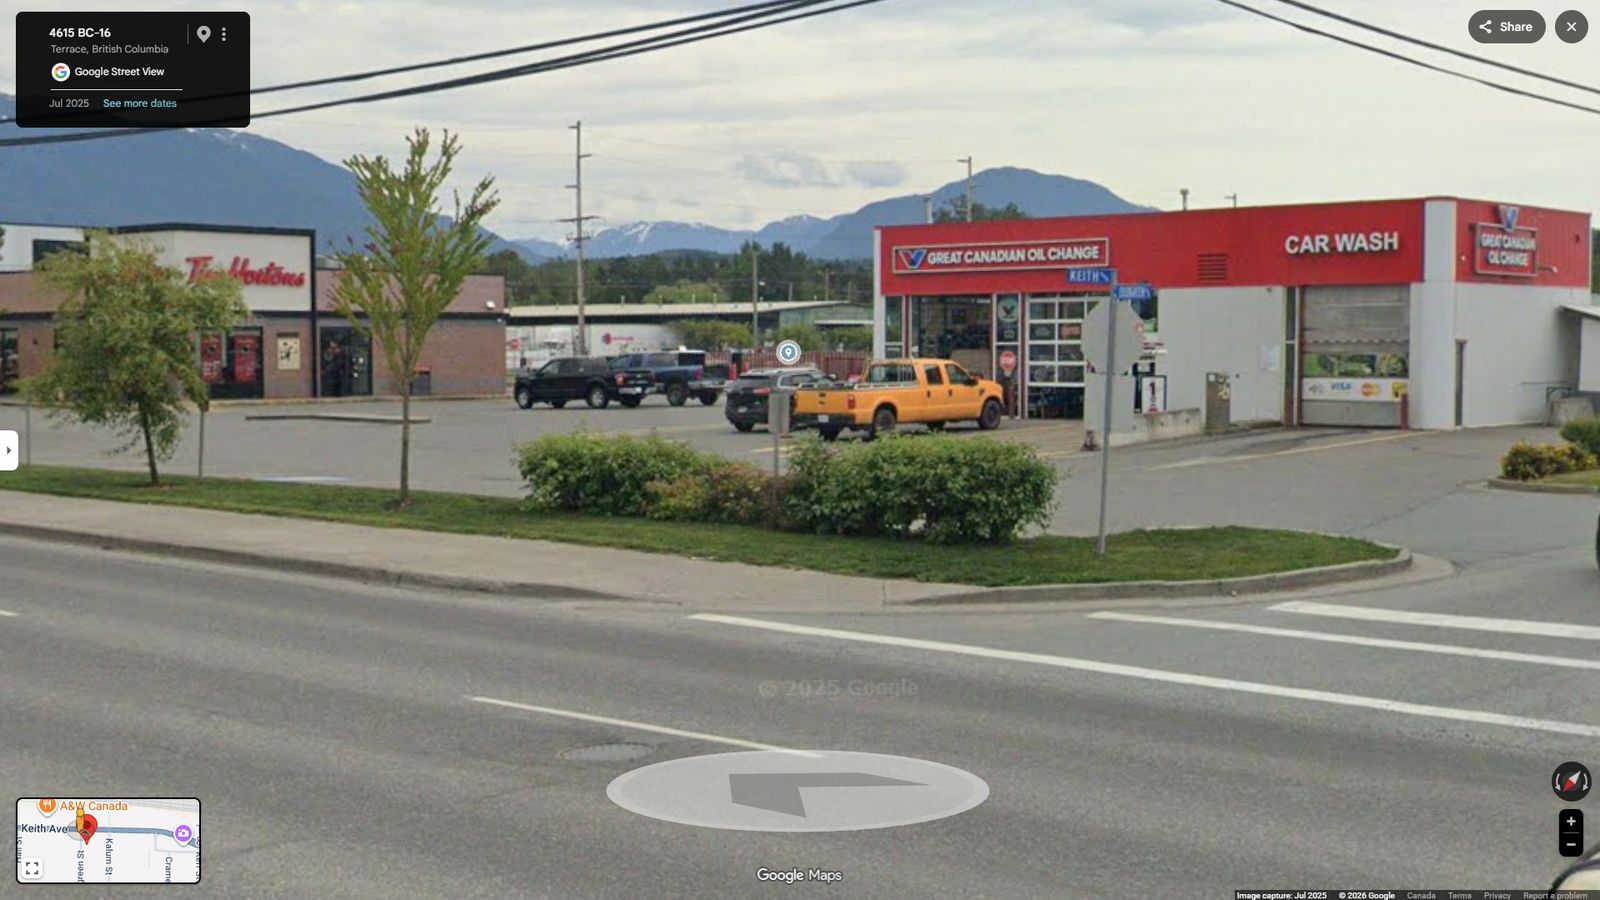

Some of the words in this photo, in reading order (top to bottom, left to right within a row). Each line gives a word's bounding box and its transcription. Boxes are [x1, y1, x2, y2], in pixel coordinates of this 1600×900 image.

[1285, 234, 1330, 254] CAR
[1334, 231, 1399, 252] WASH
[928, 250, 964, 265] GREAT
[963, 249, 1026, 264] CANADIAN
[1027, 248, 1046, 262] OIL
[1048, 246, 1099, 260] CHANGE
[228, 256, 305, 287] Hortons
[1069, 269, 1099, 282] KEITH
